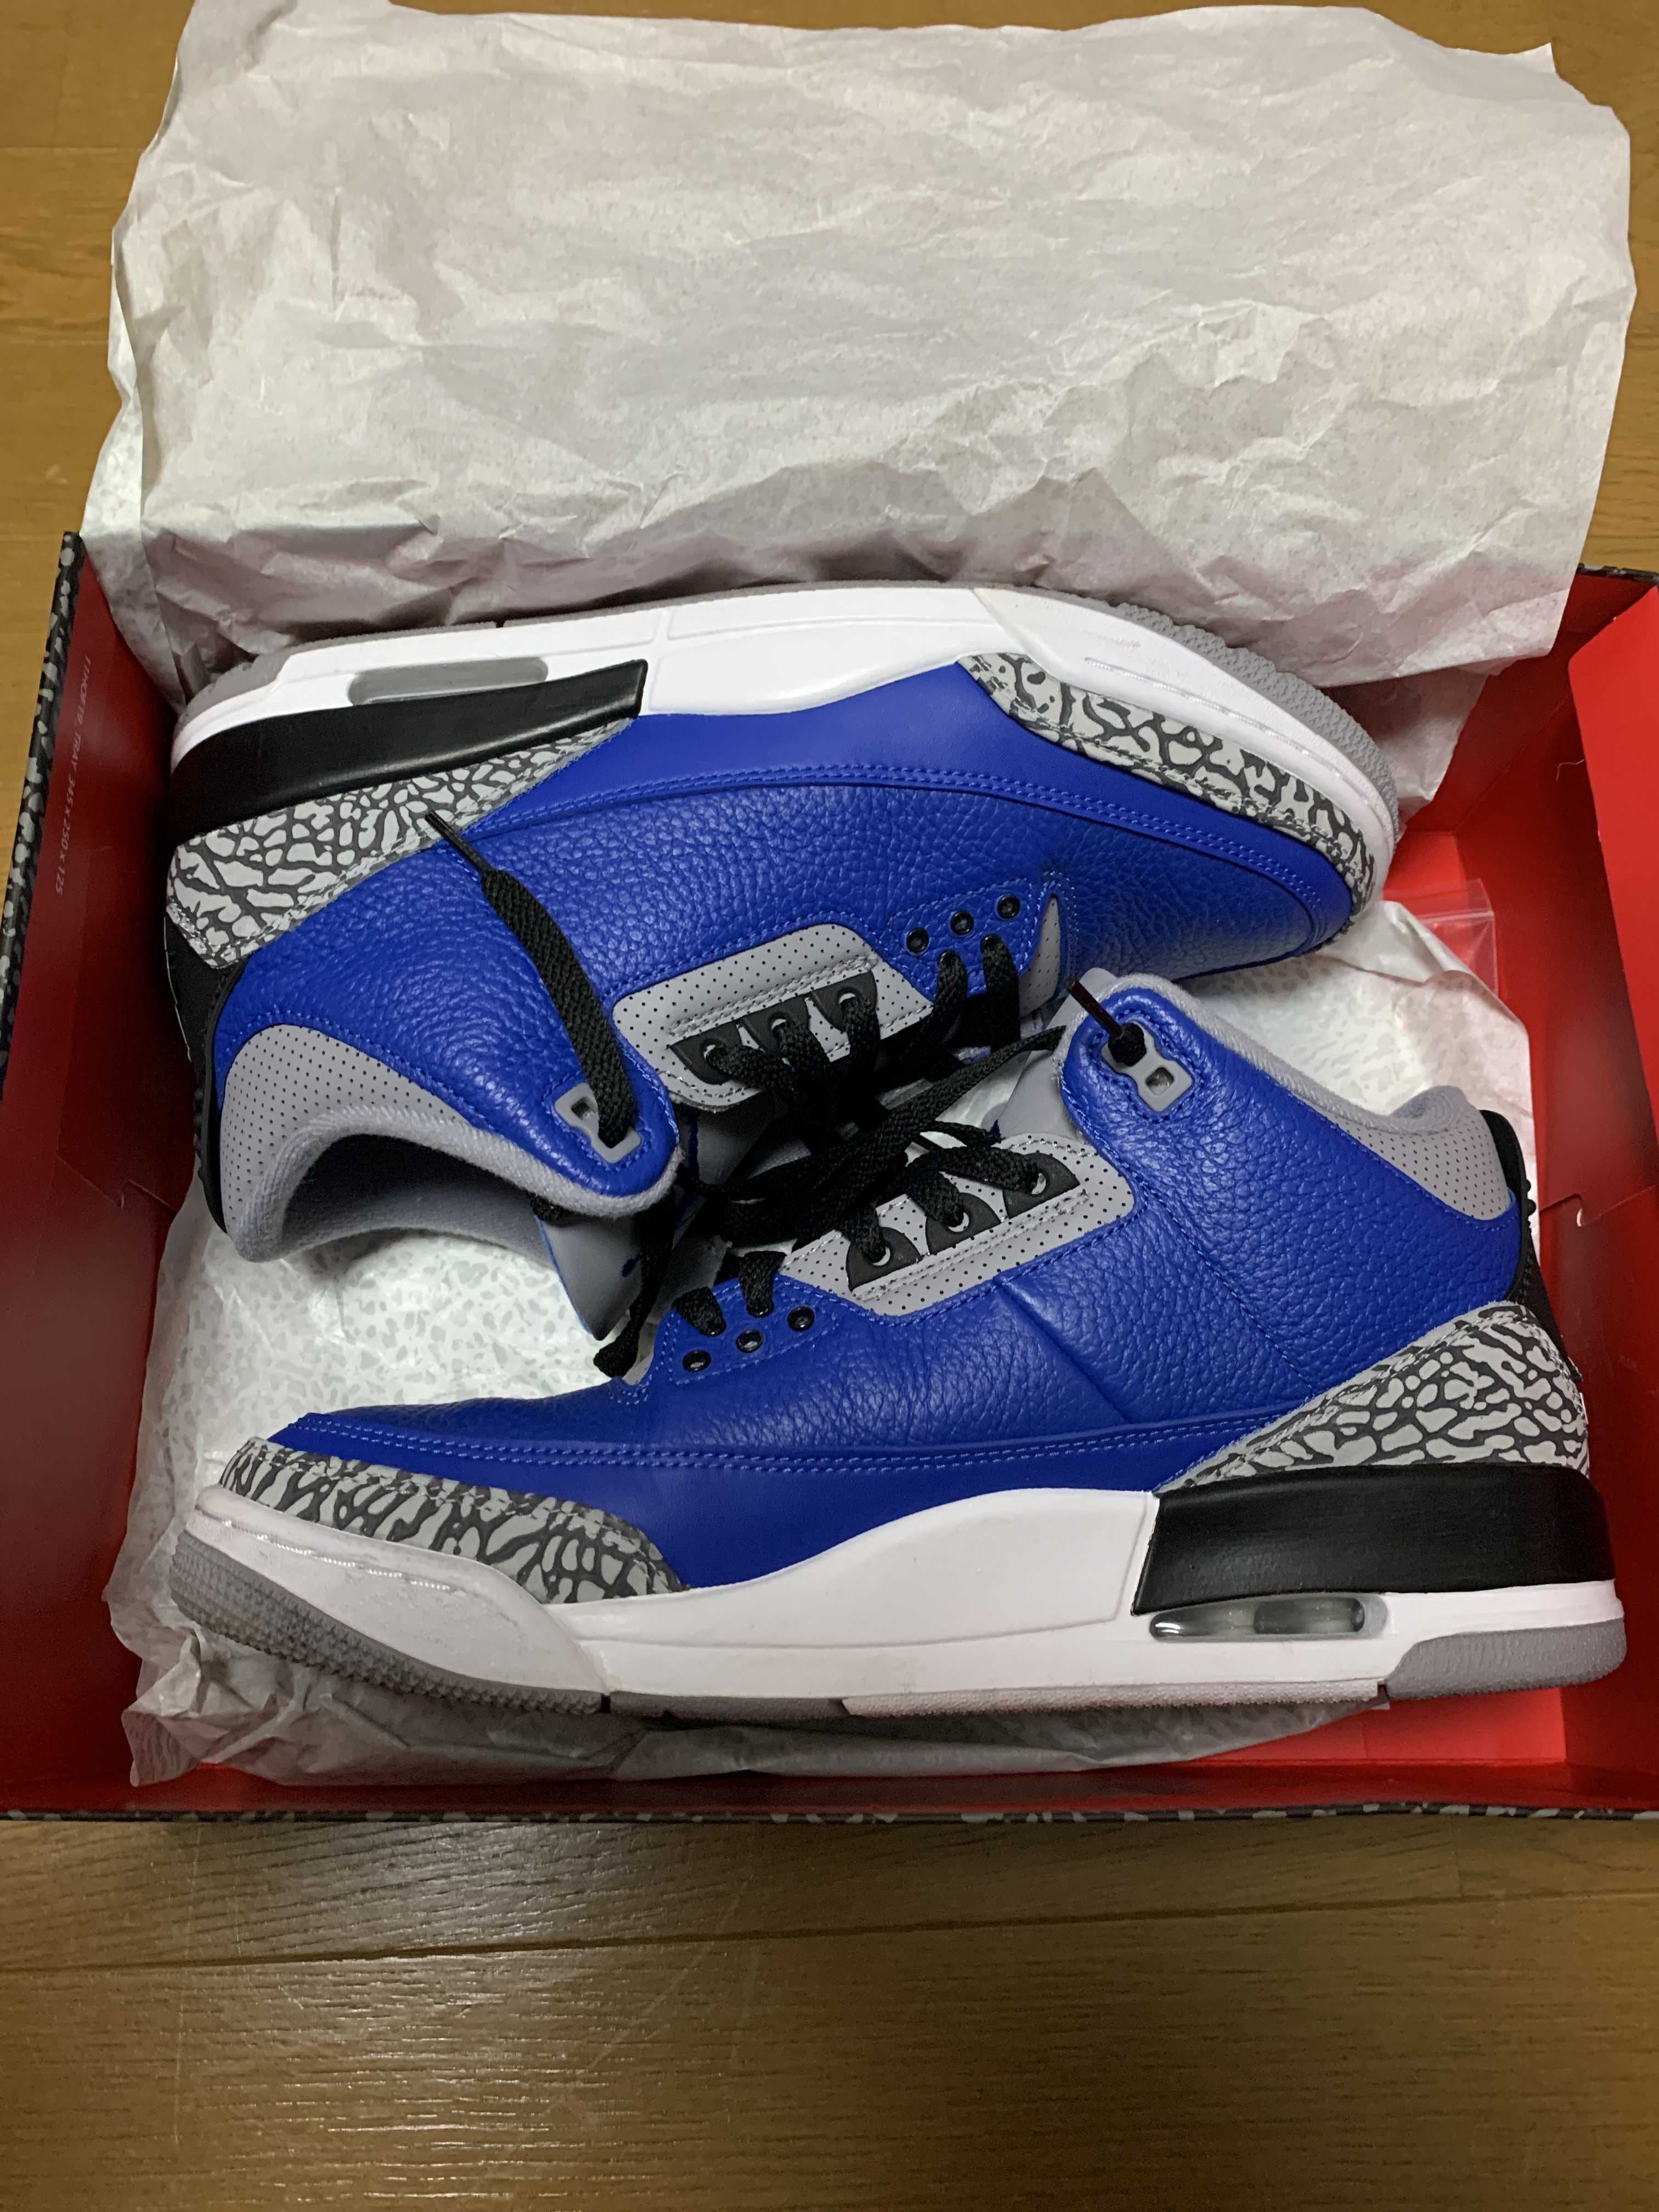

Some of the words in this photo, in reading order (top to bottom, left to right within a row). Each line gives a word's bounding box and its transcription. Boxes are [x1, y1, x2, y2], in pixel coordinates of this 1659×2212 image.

[65, 774, 75, 805] 345
[64, 805, 70, 817] x
[60, 819, 70, 850] 250
[58, 850, 65, 862] x
[55, 866, 65, 895] 125
